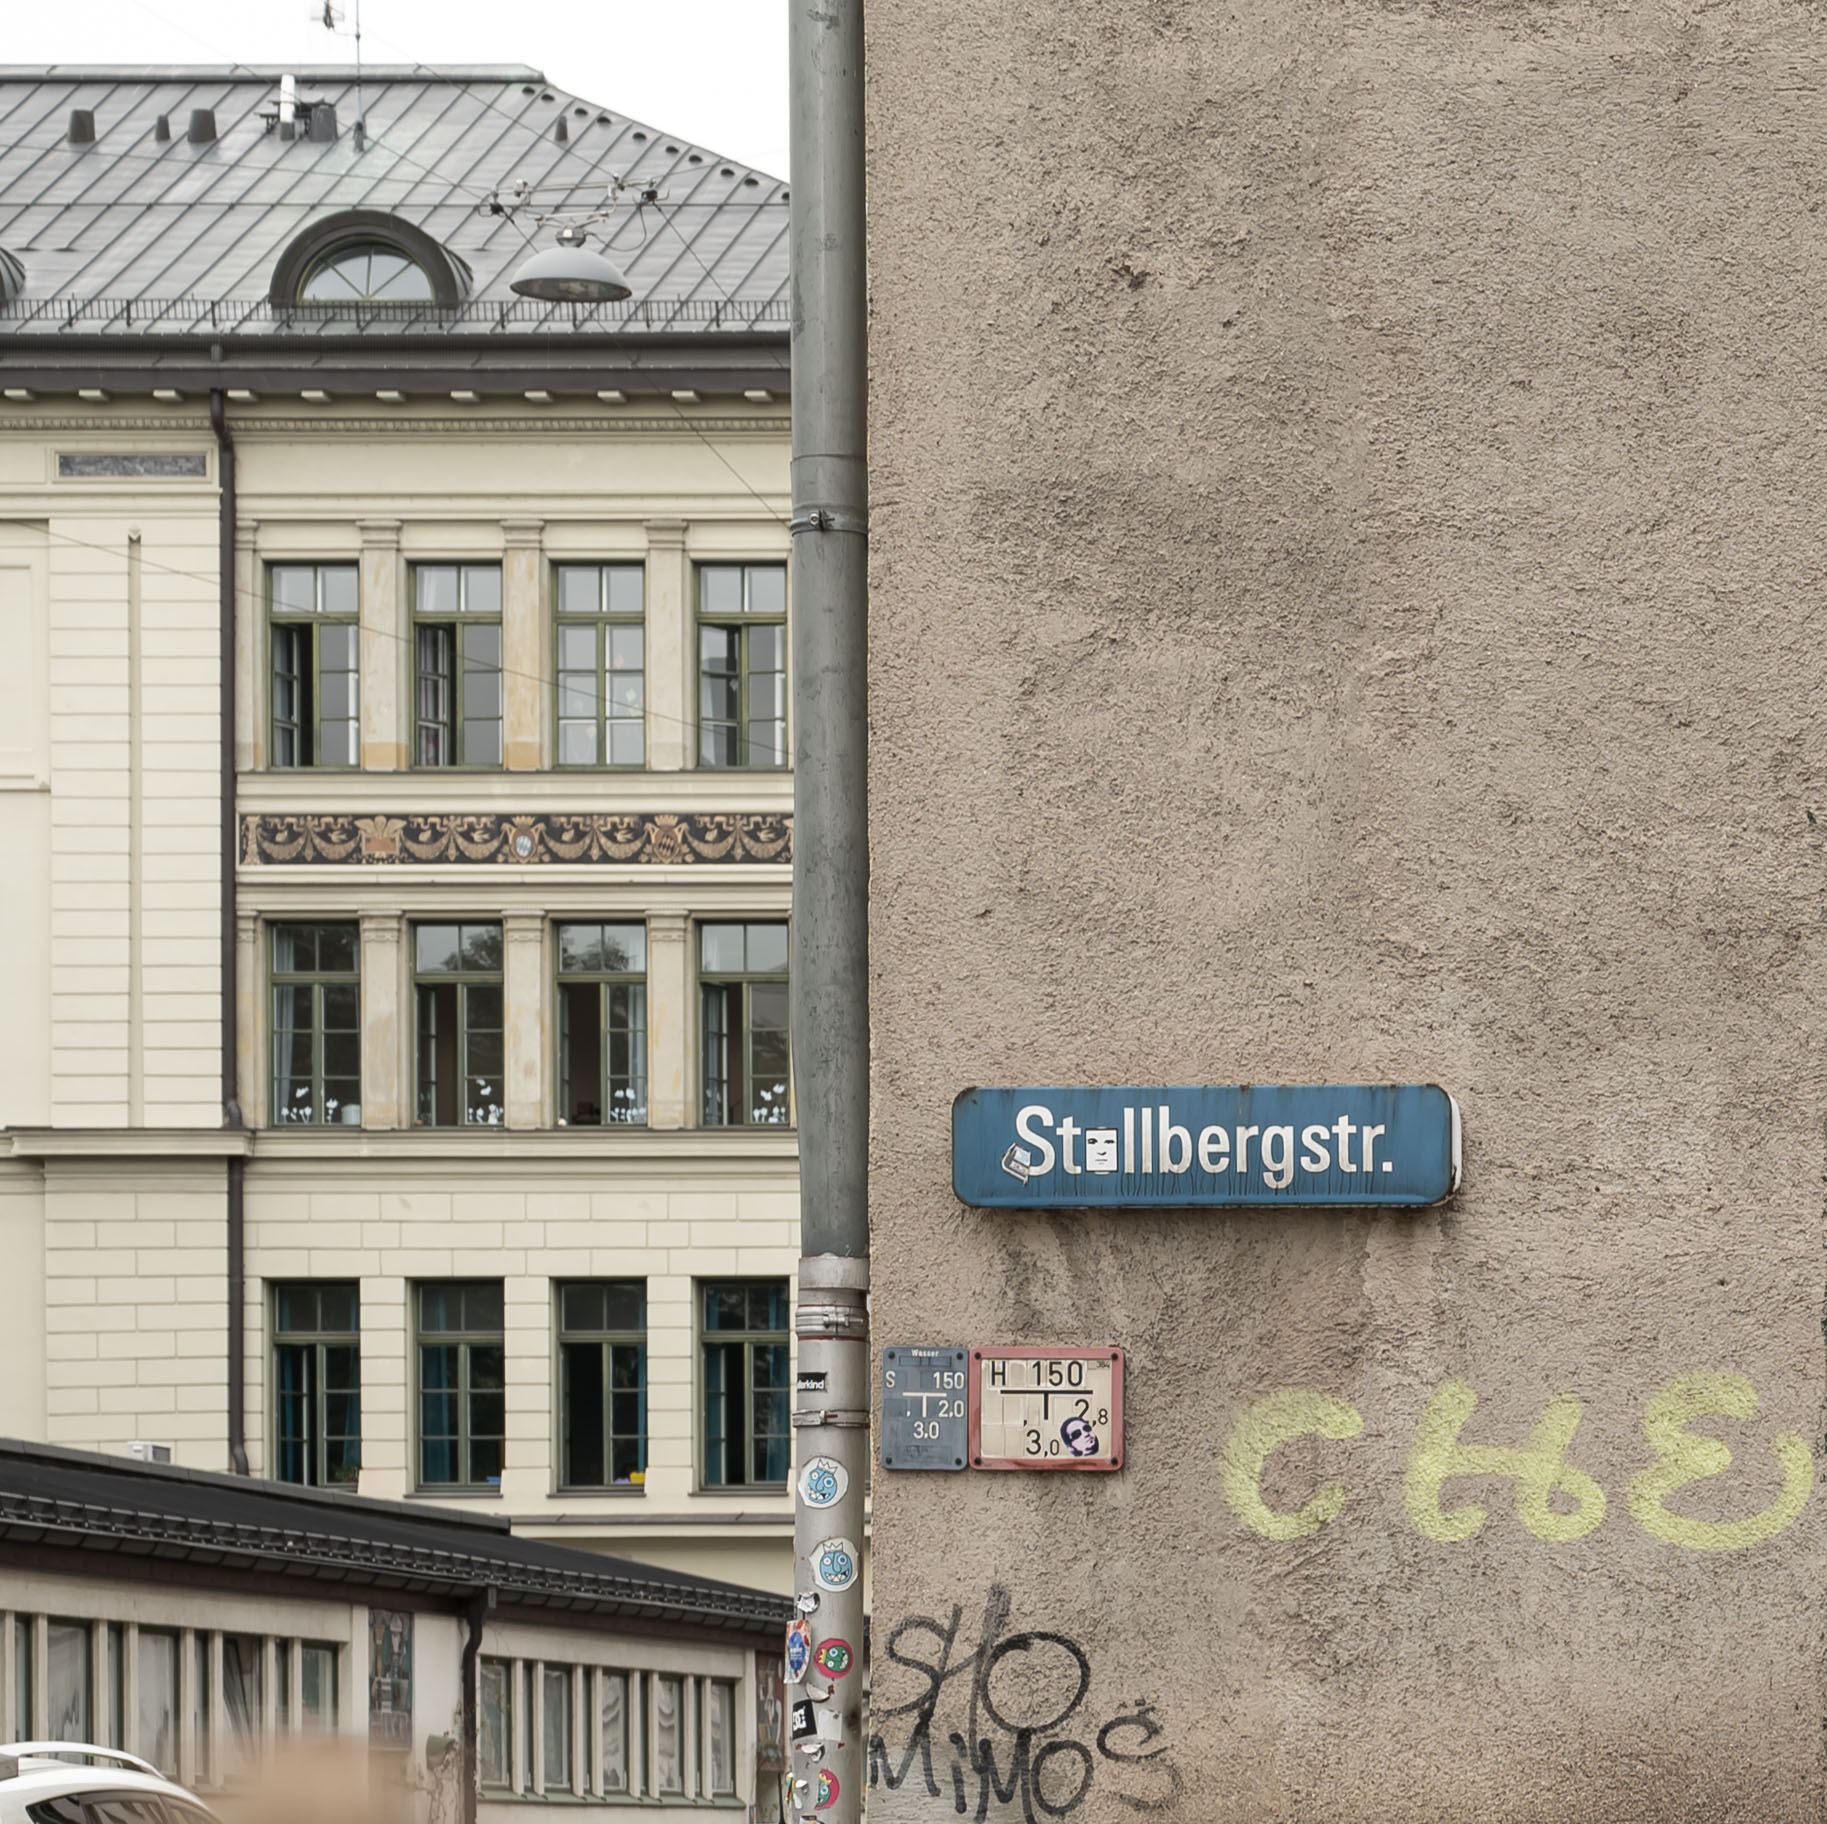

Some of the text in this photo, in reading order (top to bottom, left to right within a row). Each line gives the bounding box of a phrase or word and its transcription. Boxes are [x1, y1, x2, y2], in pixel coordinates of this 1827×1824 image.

[1015, 1104, 1394, 1190] Stllbergstr.
[911, 1348, 940, 1358] Wasser
[885, 1370, 965, 1390] S 150
[990, 1360, 1084, 1387] H 150
